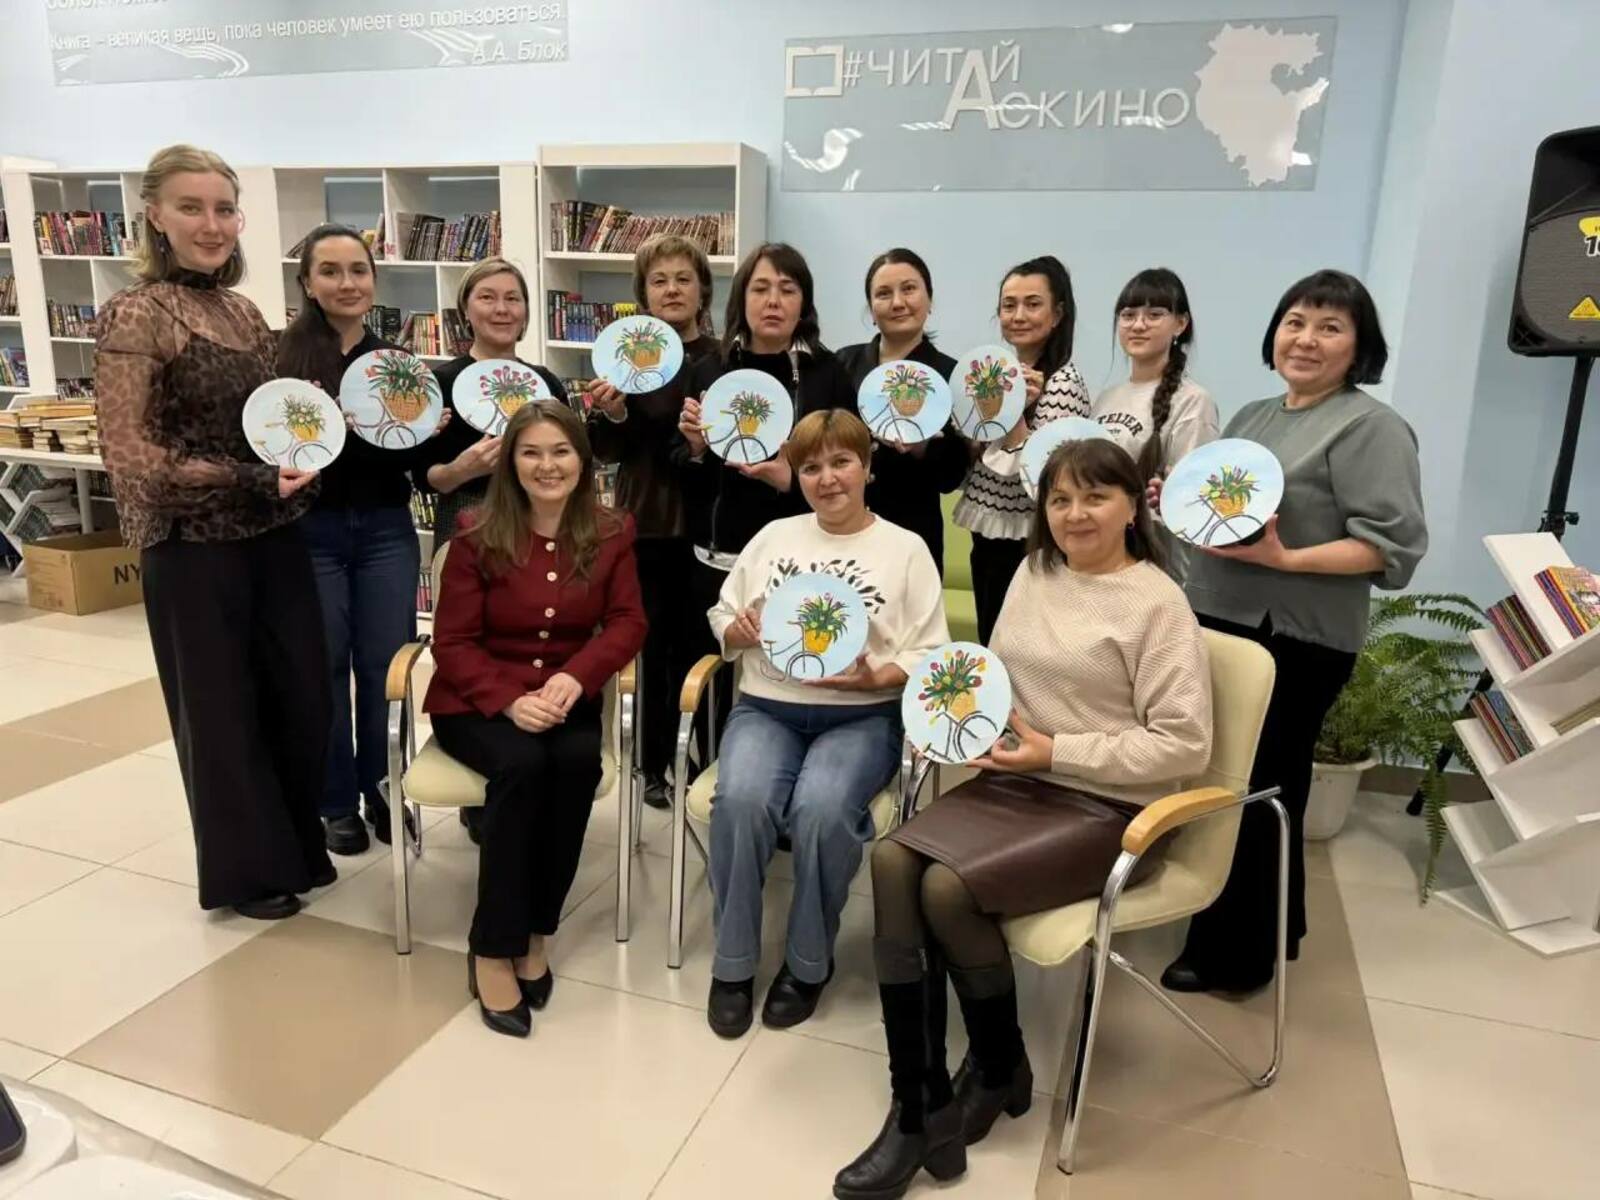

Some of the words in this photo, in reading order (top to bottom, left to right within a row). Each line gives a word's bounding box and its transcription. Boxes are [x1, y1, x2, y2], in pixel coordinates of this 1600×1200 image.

[107, 29, 170, 47] великая
[174, 26, 221, 43] вещь,
[224, 22, 263, 40] пока
[266, 17, 337, 37] человек
[340, 13, 393, 37] умеет
[398, 11, 425, 29] ею
[429, 3, 562, 27] пользоваться
[516, 40, 568, 62] Блок
[1097, 412, 1143, 437] TELIER
